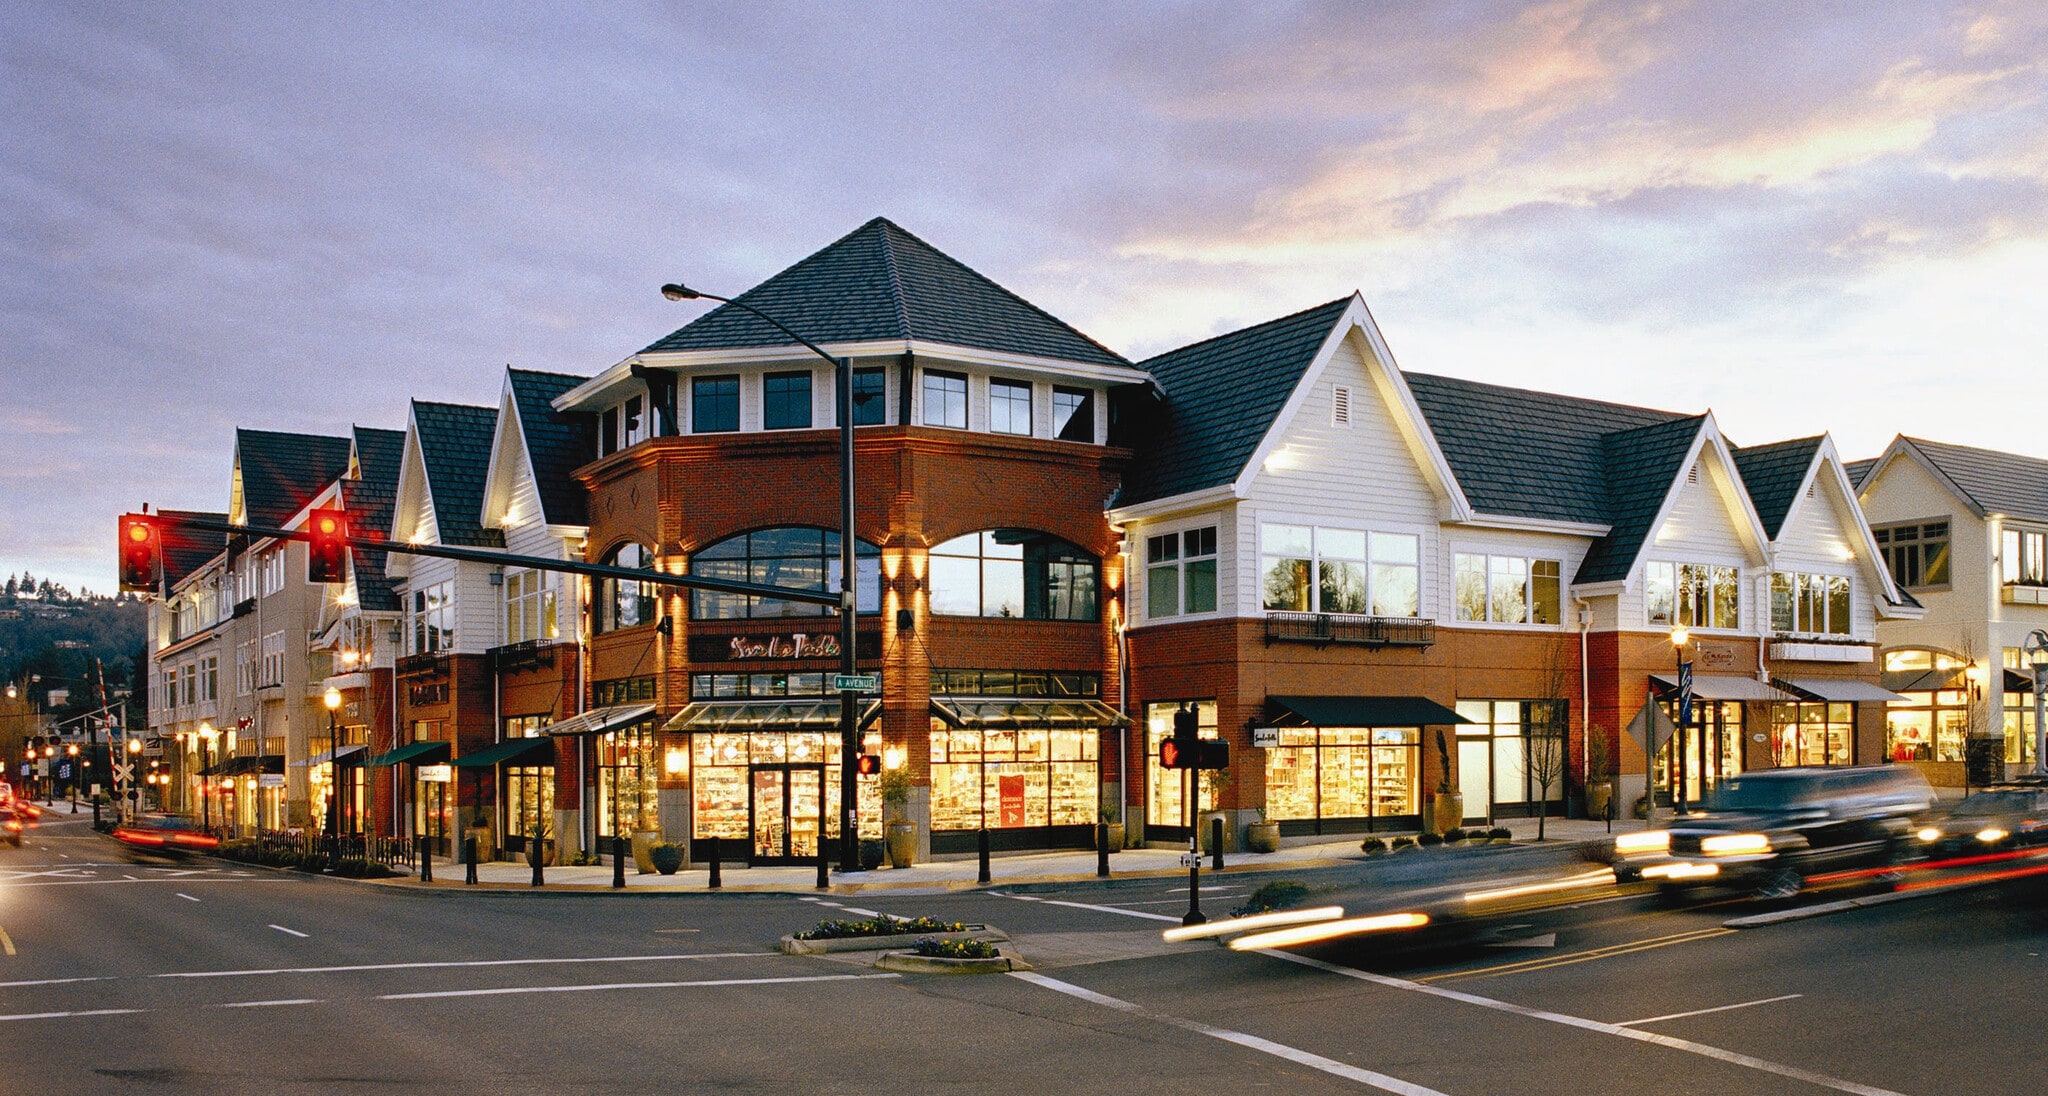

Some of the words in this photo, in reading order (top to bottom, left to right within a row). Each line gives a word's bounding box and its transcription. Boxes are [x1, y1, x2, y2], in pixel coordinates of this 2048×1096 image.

[793, 633, 841, 659] Table
[837, 678, 843, 688] A
[845, 678, 874, 689] AVENUE
